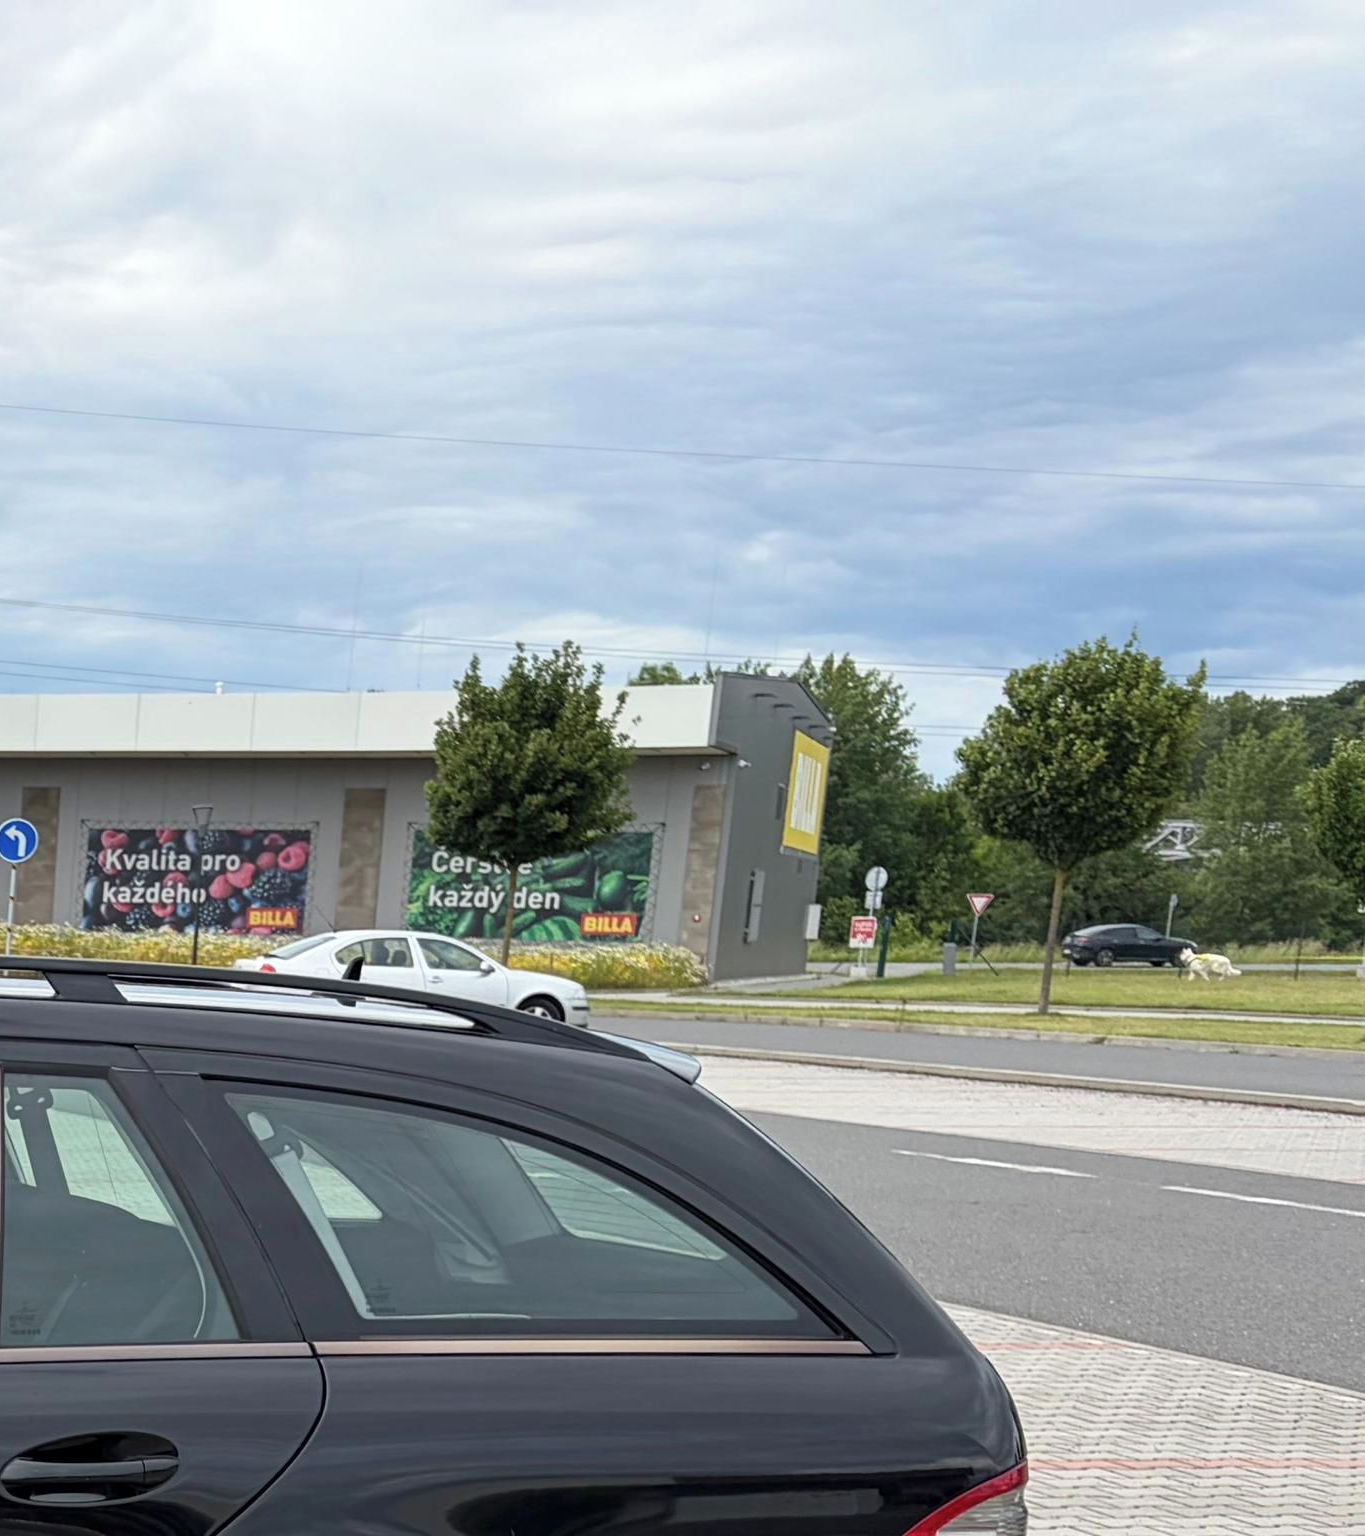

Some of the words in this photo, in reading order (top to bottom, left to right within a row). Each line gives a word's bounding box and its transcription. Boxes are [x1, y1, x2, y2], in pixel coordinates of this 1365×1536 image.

[105, 849, 191, 871] Kvalita
[200, 853, 240, 875] pro
[102, 878, 207, 904] každého
[429, 883, 506, 914] každý
[513, 886, 561, 910] den
[249, 911, 294, 926] BILLA
[582, 916, 633, 933] BILLA
